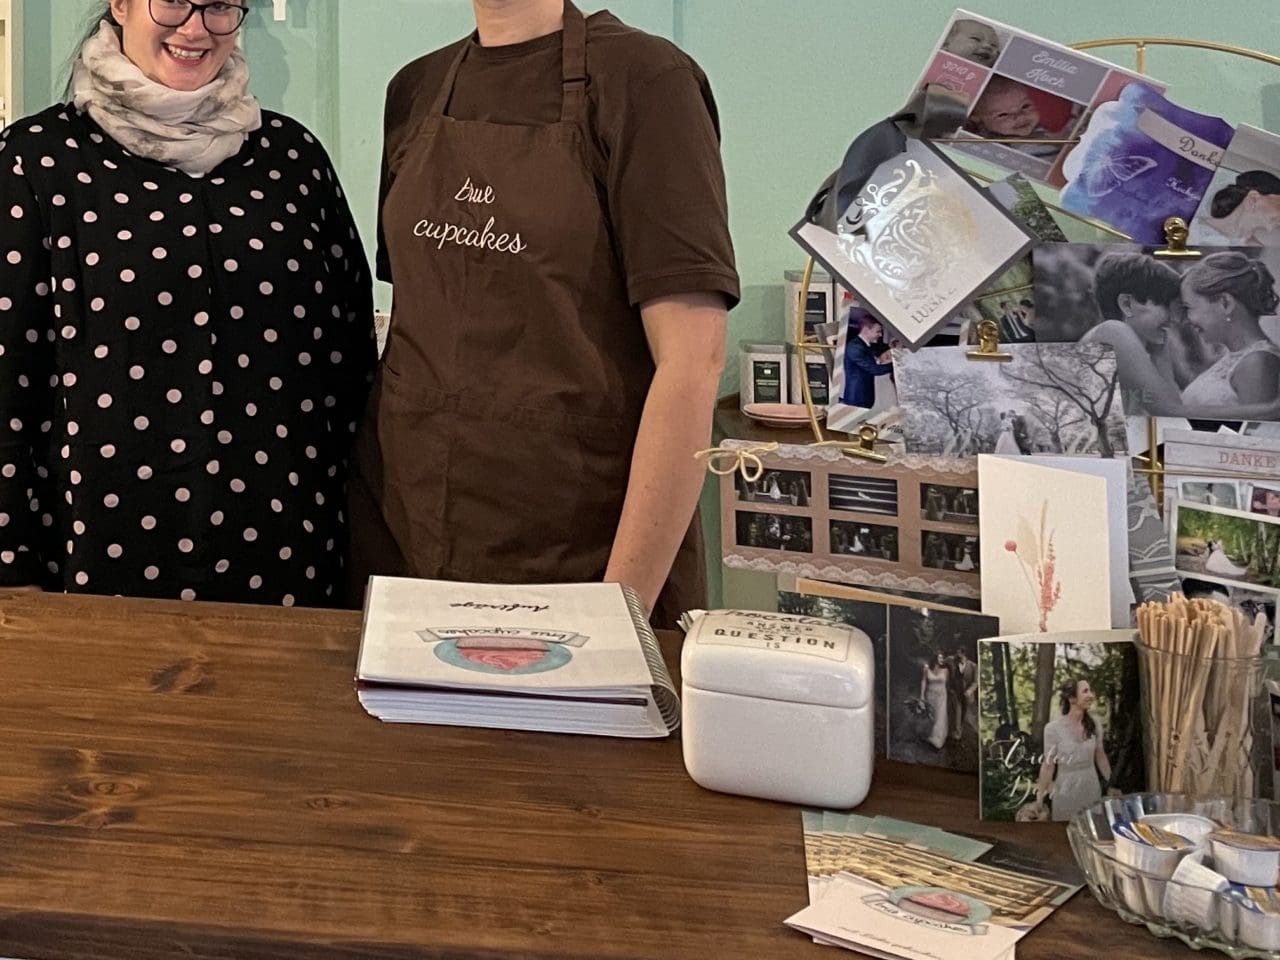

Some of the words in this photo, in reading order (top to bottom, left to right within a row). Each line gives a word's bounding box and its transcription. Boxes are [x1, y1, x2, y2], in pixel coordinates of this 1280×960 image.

[454, 177, 495, 204] true
[413, 216, 527, 254] cupcakes
[1219, 450, 1277, 469] DANKE
[529, 629, 566, 640] true
[714, 628, 835, 649] QUESTION
